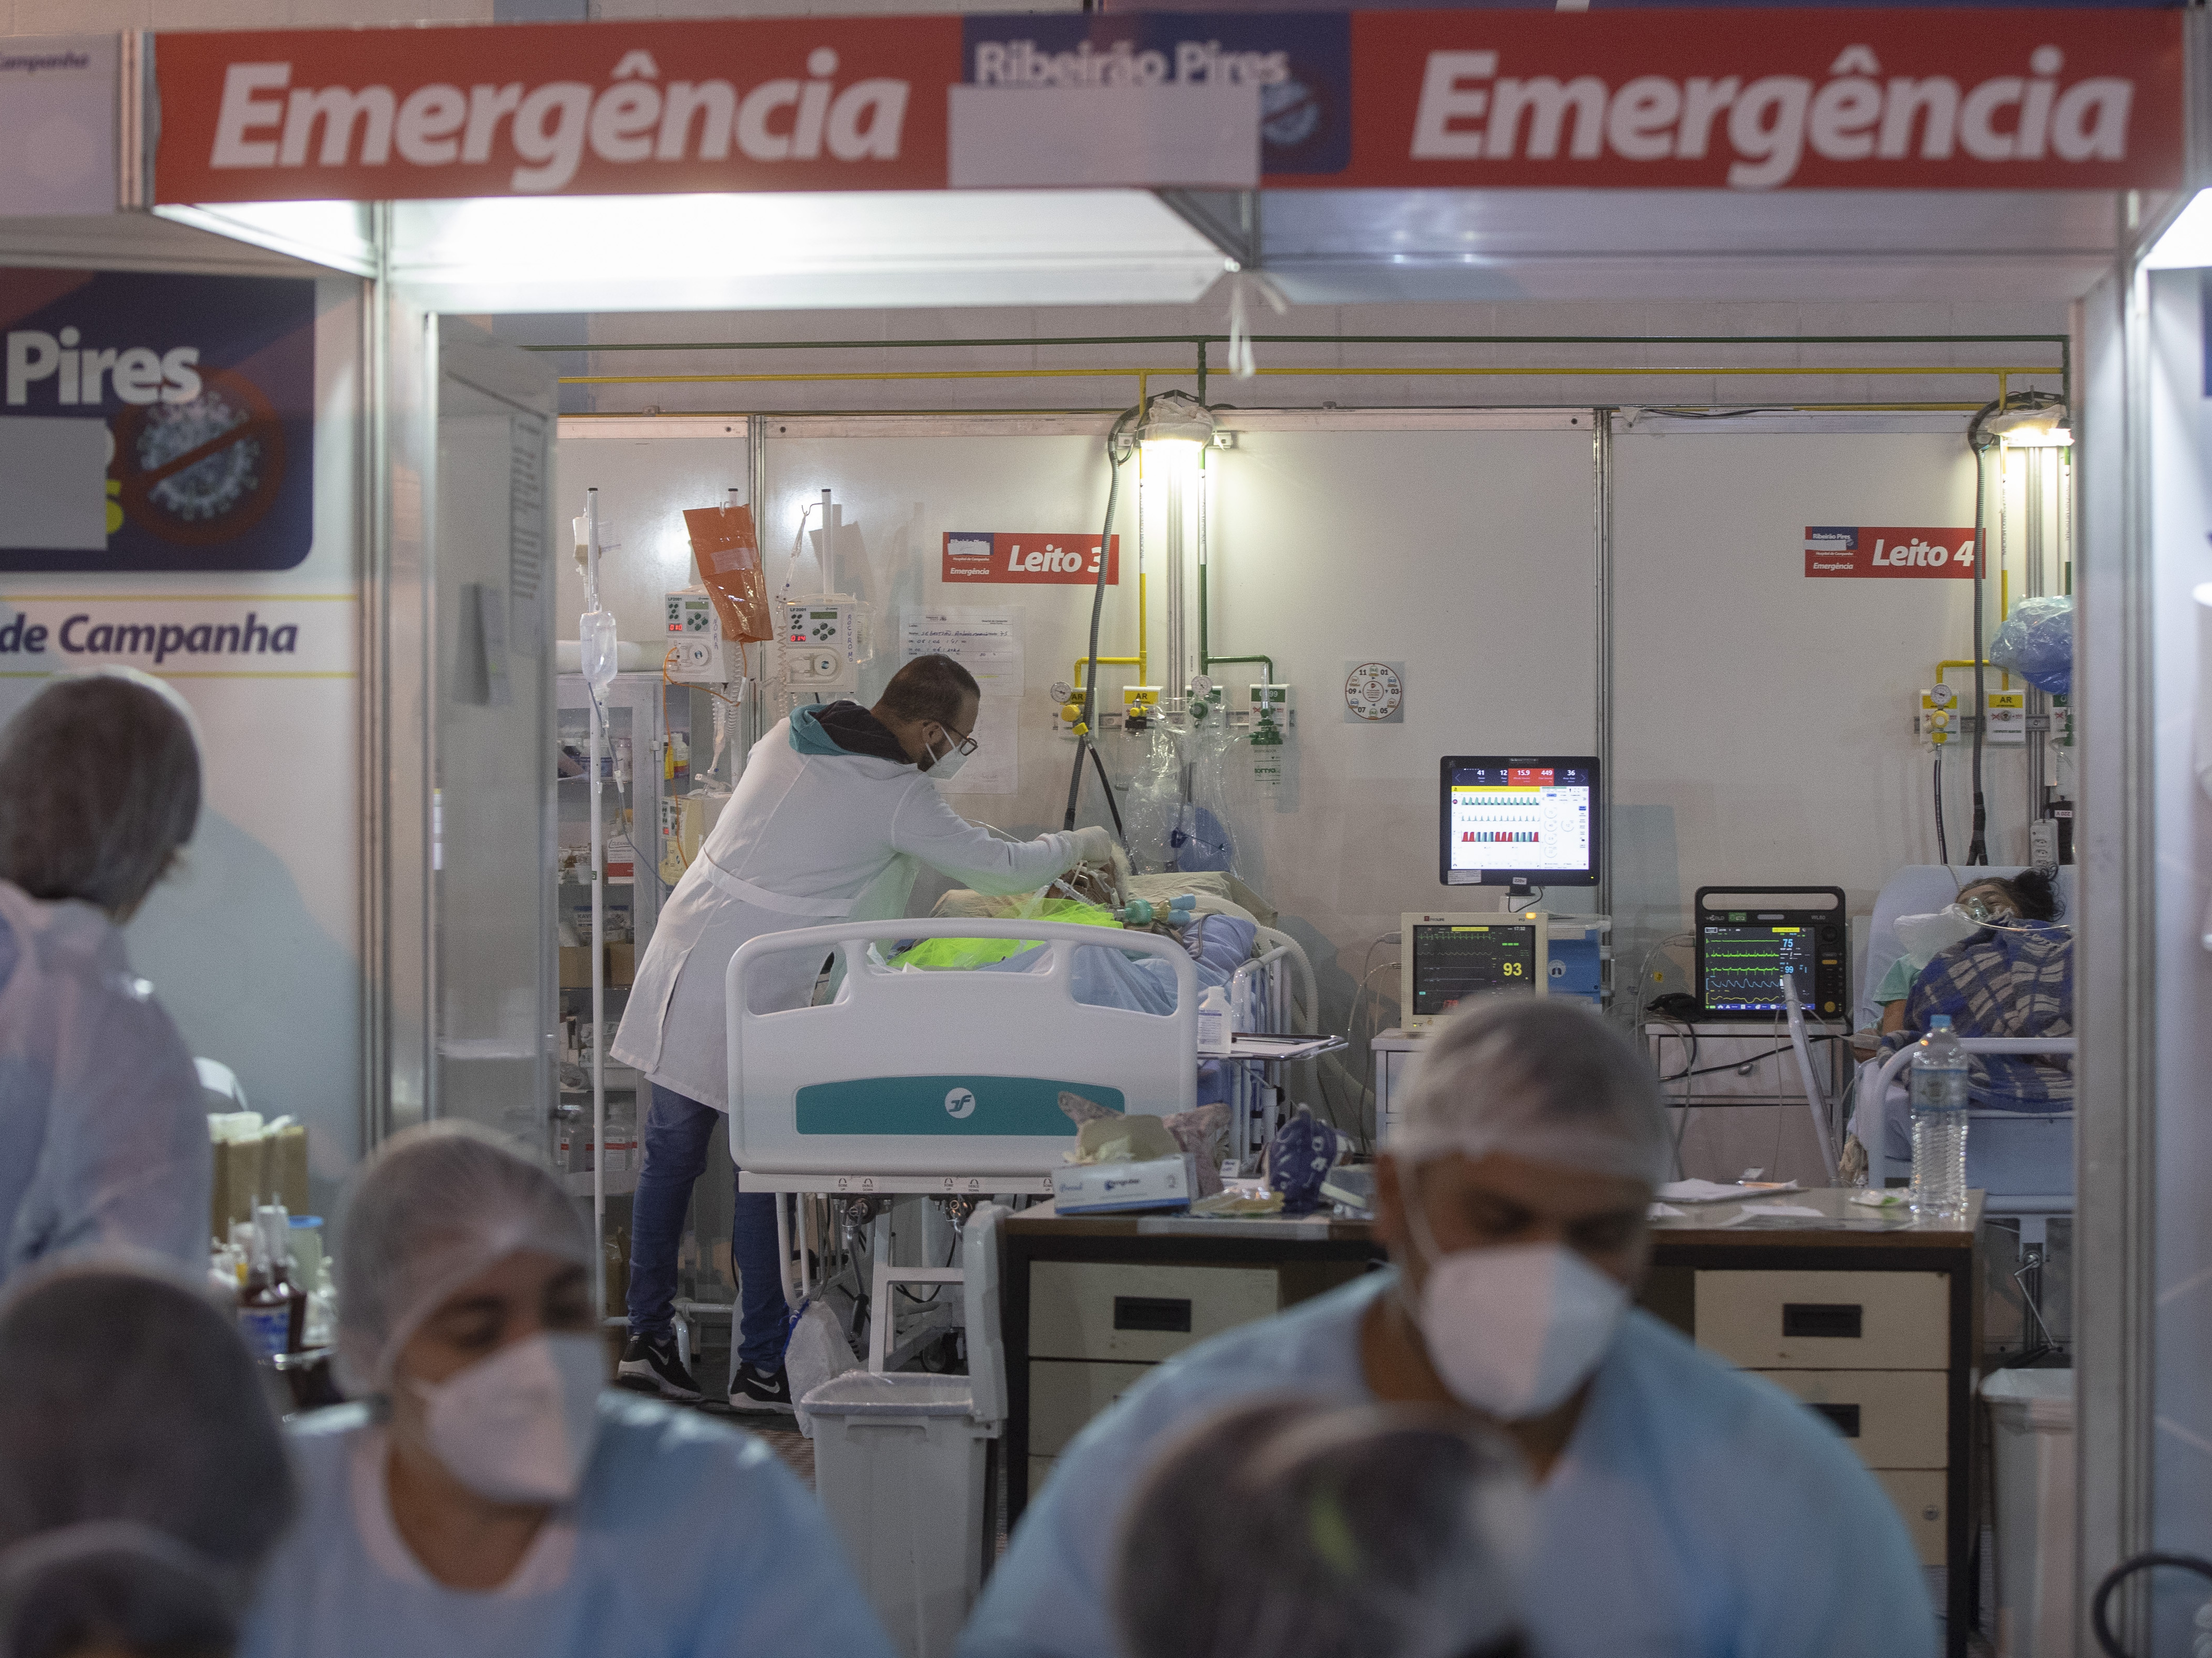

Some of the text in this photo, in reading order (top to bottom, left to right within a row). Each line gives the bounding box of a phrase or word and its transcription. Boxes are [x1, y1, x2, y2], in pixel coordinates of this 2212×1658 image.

[975, 39, 1289, 84] Ribeirão Pires
[210, 48, 911, 193] Emergência
[1409, 44, 2135, 189] Emergência
[6, 326, 202, 406] Pires
[1007, 544, 1102, 573] Leito 3
[1813, 562, 1853, 571] Emergência
[1872, 538, 1974, 567] Leito 4
[950, 568, 990, 576] Emergência
[59, 612, 299, 665] Campanha
[1783, 939, 1793, 947] 75
[1503, 962, 1522, 976] 93
